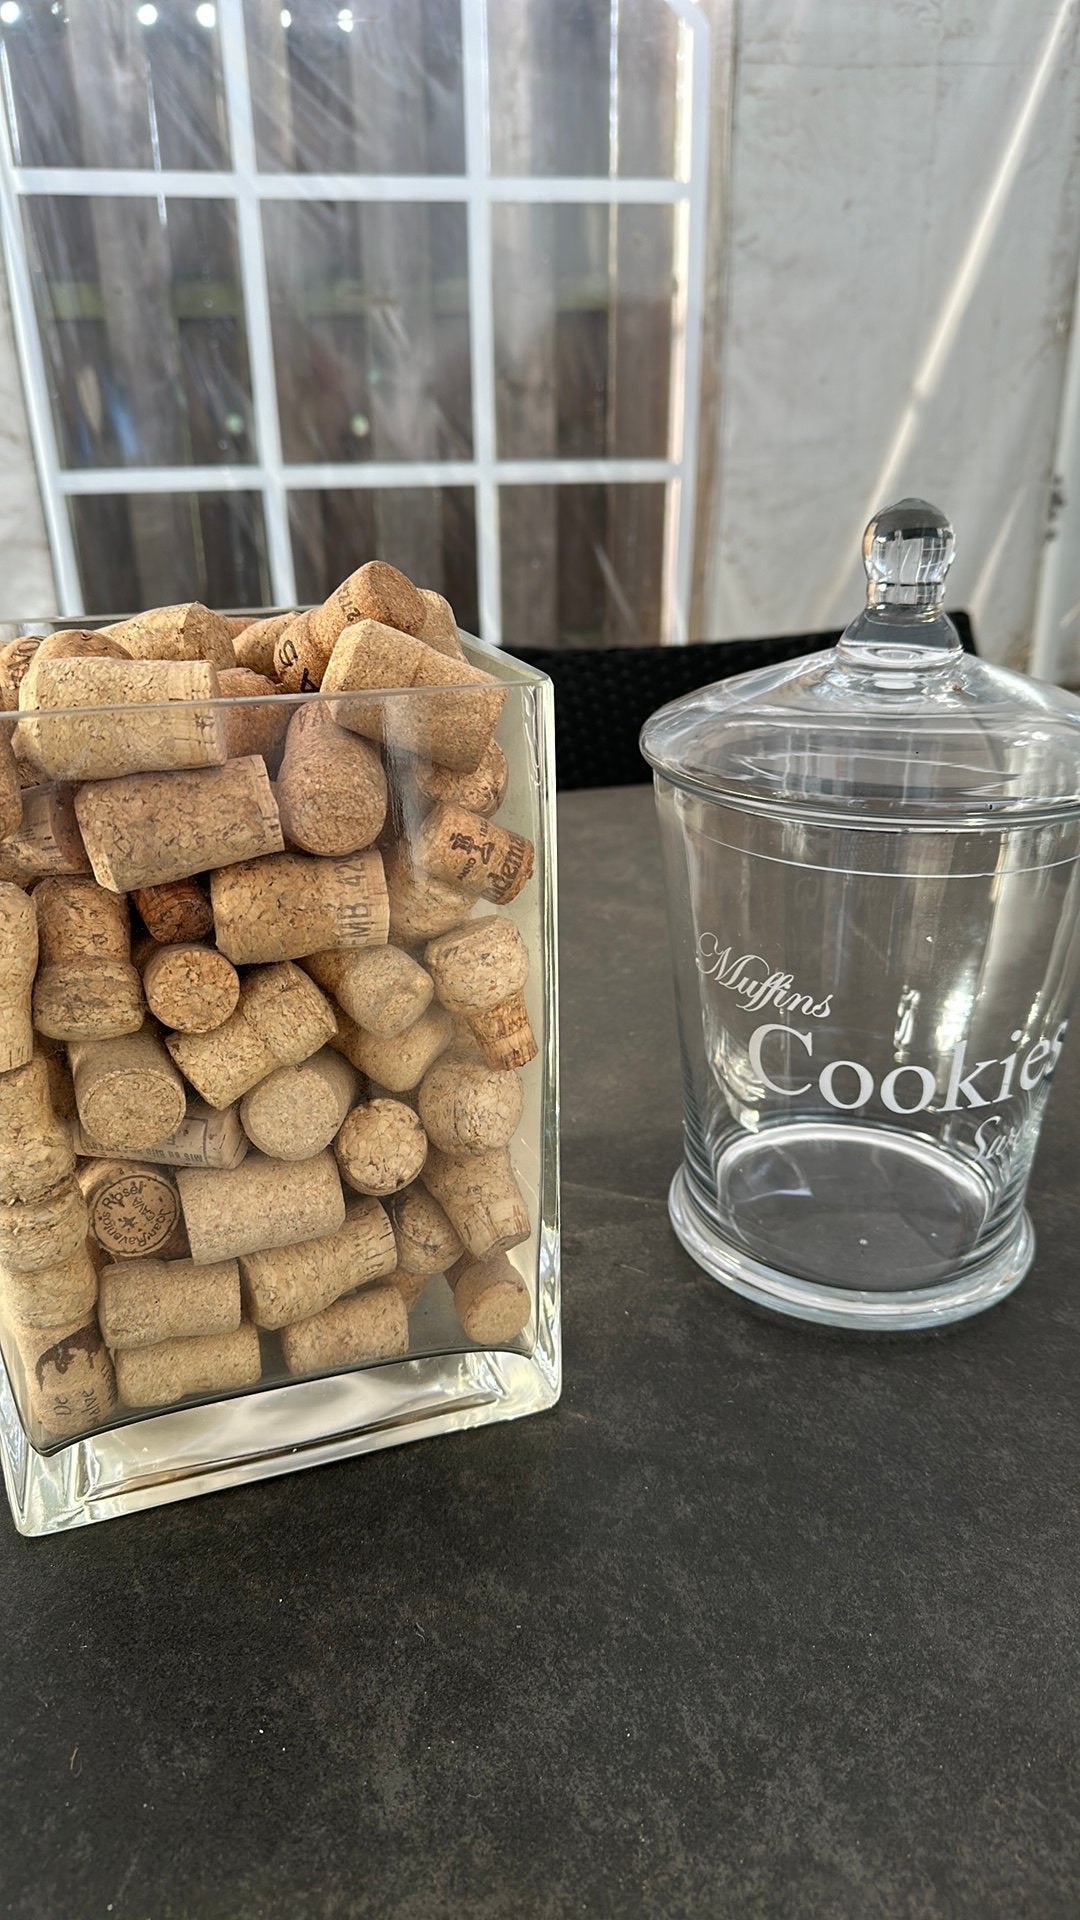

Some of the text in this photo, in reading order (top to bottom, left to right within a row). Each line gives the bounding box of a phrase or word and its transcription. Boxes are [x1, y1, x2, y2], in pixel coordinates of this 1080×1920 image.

[697, 931, 834, 1018] Muffins
[748, 1018, 1068, 1115] Cookies
[132, 1196, 157, 1221] CAVA
[148, 1208, 172, 1237] Joan
[102, 1211, 148, 1248] Raventos
[53, 1396, 72, 1416] De
